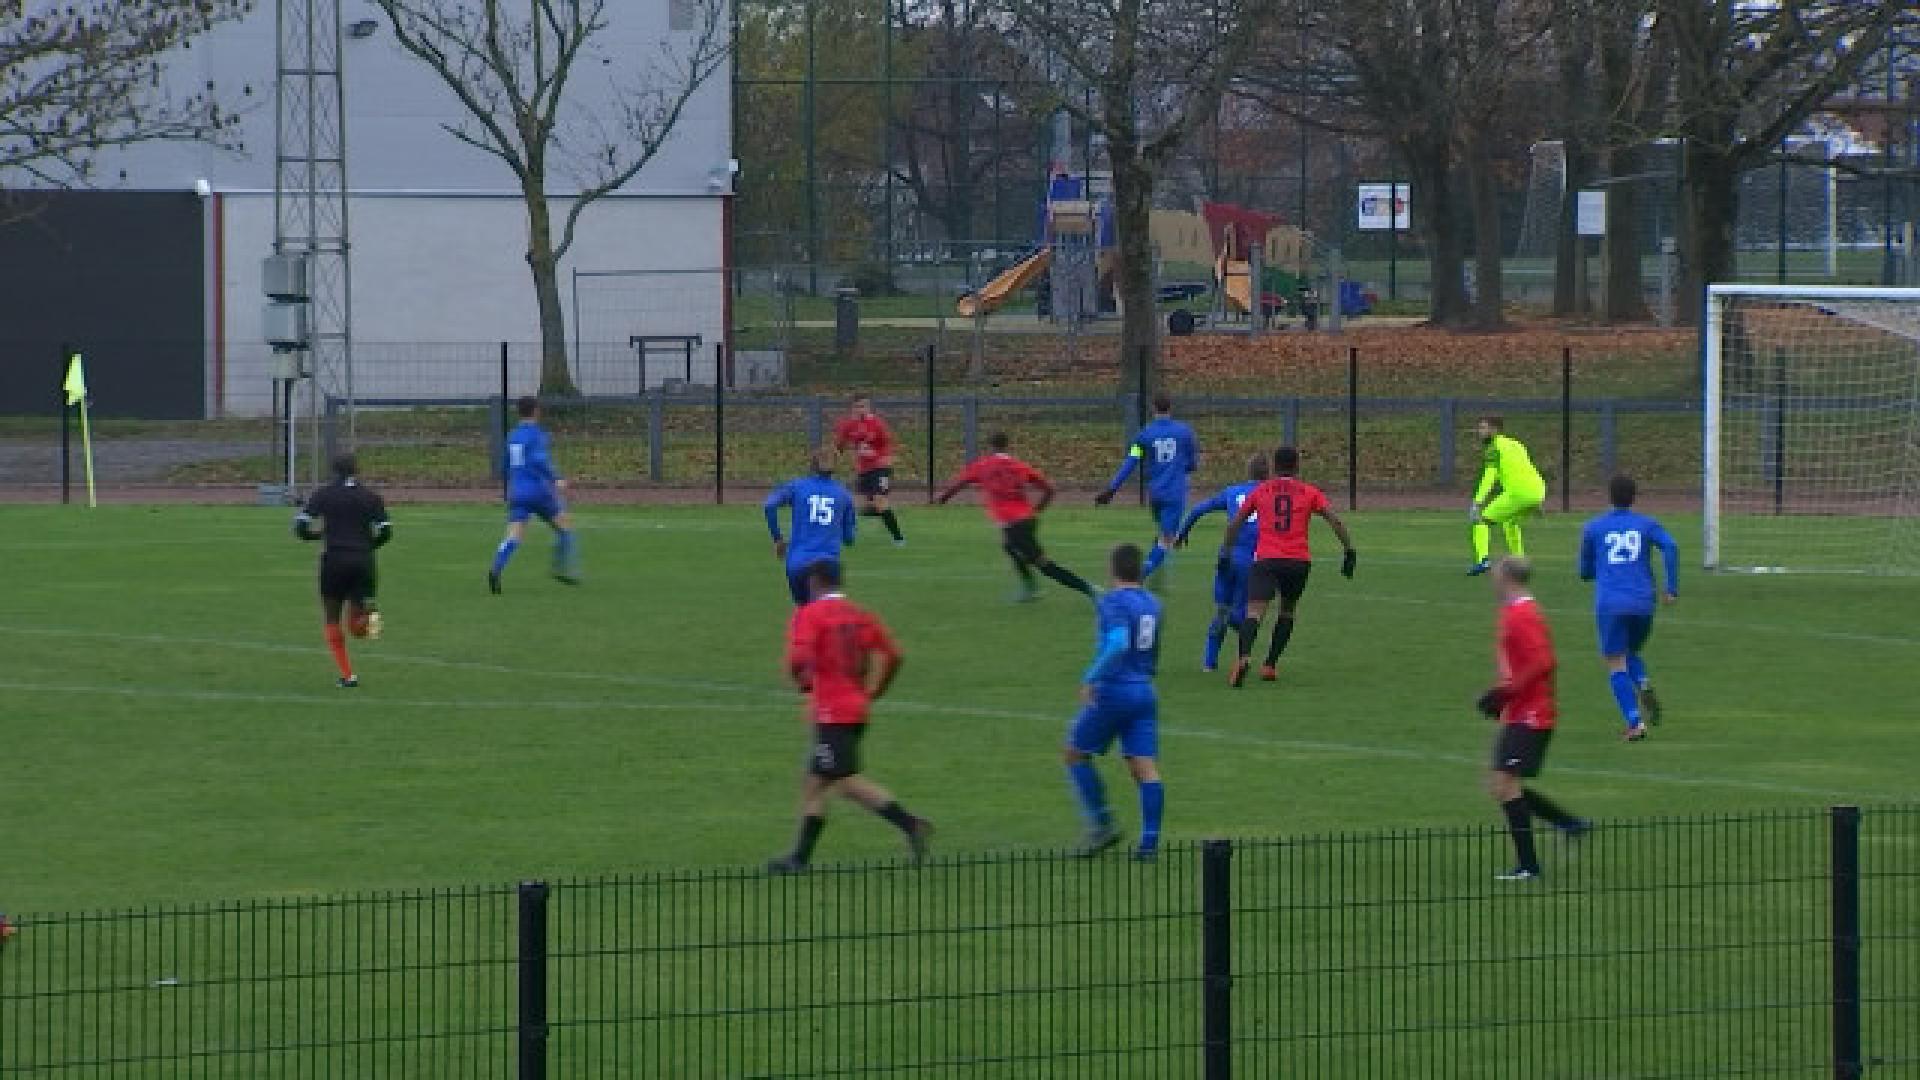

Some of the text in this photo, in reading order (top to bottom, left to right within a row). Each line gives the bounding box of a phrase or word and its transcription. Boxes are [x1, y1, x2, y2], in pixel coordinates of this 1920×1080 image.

[807, 495, 834, 525] 15
[1274, 495, 1291, 532] 9
[1605, 530, 1641, 564] 29
